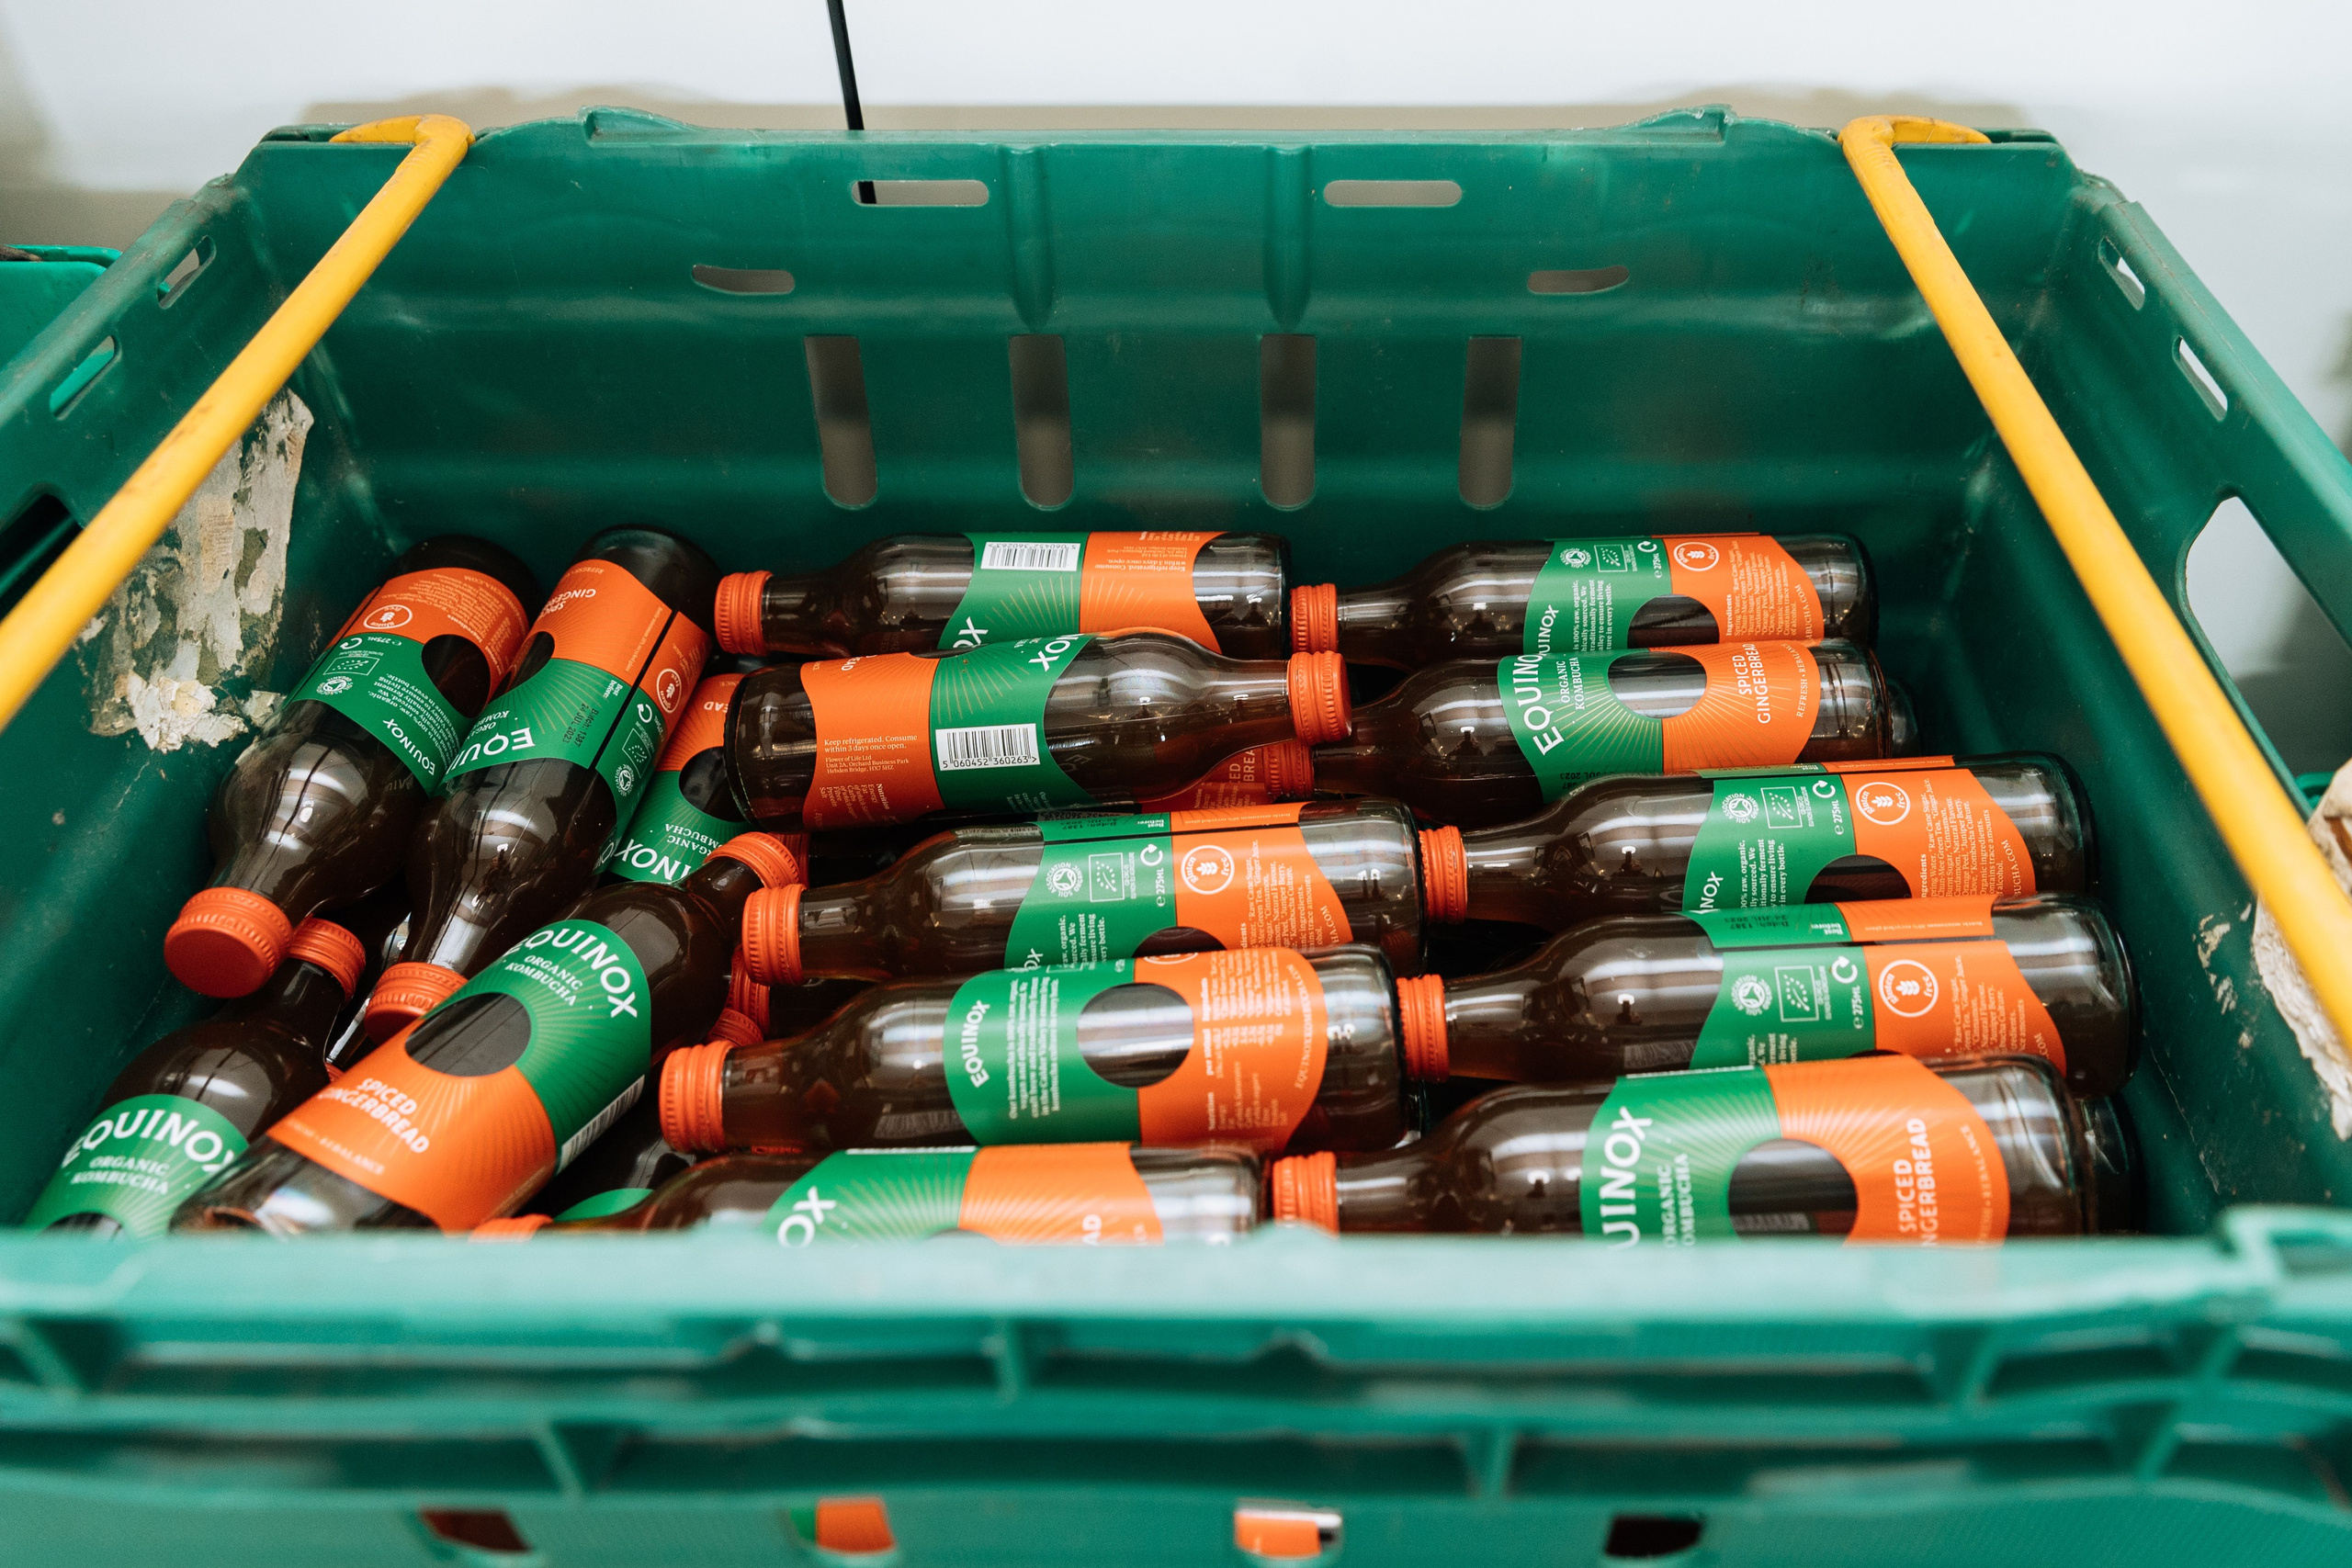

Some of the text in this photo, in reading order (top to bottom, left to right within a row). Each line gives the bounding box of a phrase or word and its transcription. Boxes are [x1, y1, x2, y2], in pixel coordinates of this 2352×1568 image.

[1581, 585, 1587, 595] We
[1538, 604, 1558, 656] UINOX
[1555, 660, 1570, 703] ORGANIC
[1569, 657, 1585, 710] KOMBUCHA
[1732, 655, 1752, 694] SPICED
[1742, 643, 1770, 723] GINGERBREAD
[377, 687, 389, 697] We
[602, 678, 616, 699] before:
[612, 682, 623, 696] Best
[1795, 678, 1807, 716] REFRESH
[1512, 654, 1564, 755] EQUINO
[570, 713, 582, 728] JUL
[571, 706, 598, 748] Batch: 1387
[382, 716, 435, 775] EQUINOX
[560, 725, 576, 744] 2023
[842, 736, 884, 744] refrigerated.
[954, 758, 988, 767] 060452
[992, 755, 1028, 764] 360263
[1831, 799, 1843, 822] 275ML
[1860, 790, 1875, 813] gluten
[1894, 791, 1905, 807] free
[1925, 813, 1933, 830] Cane
[1935, 836, 1945, 856] Green
[1951, 824, 1960, 852] Natural
[1975, 818, 1986, 862] ingredients.
[1983, 809, 1994, 863] trace amounts
[1767, 840, 1775, 863] living
[1185, 856, 1198, 883] gluten
[1219, 856, 1229, 875] free
[1748, 847, 1757, 895] sourced. We
[1768, 864, 1776, 892] ensure
[1155, 867, 1164, 894] 275ML
[1778, 872, 1786, 893] every
[1068, 922, 1075, 934] We
[1078, 913, 1086, 945] ferment
[1087, 913, 1096, 938] living
[1097, 916, 1105, 943] bottle.
[504, 963, 578, 1006] KOMBUCHA
[524, 954, 583, 991] ORGANIC
[961, 999, 990, 1087] EQUINOX
[356, 1077, 418, 1117] SPICED
[88, 1156, 170, 1175] ORGANIC
[71, 1171, 168, 1194] KOMBUCHA
[1892, 1158, 1917, 1232] SPICED
